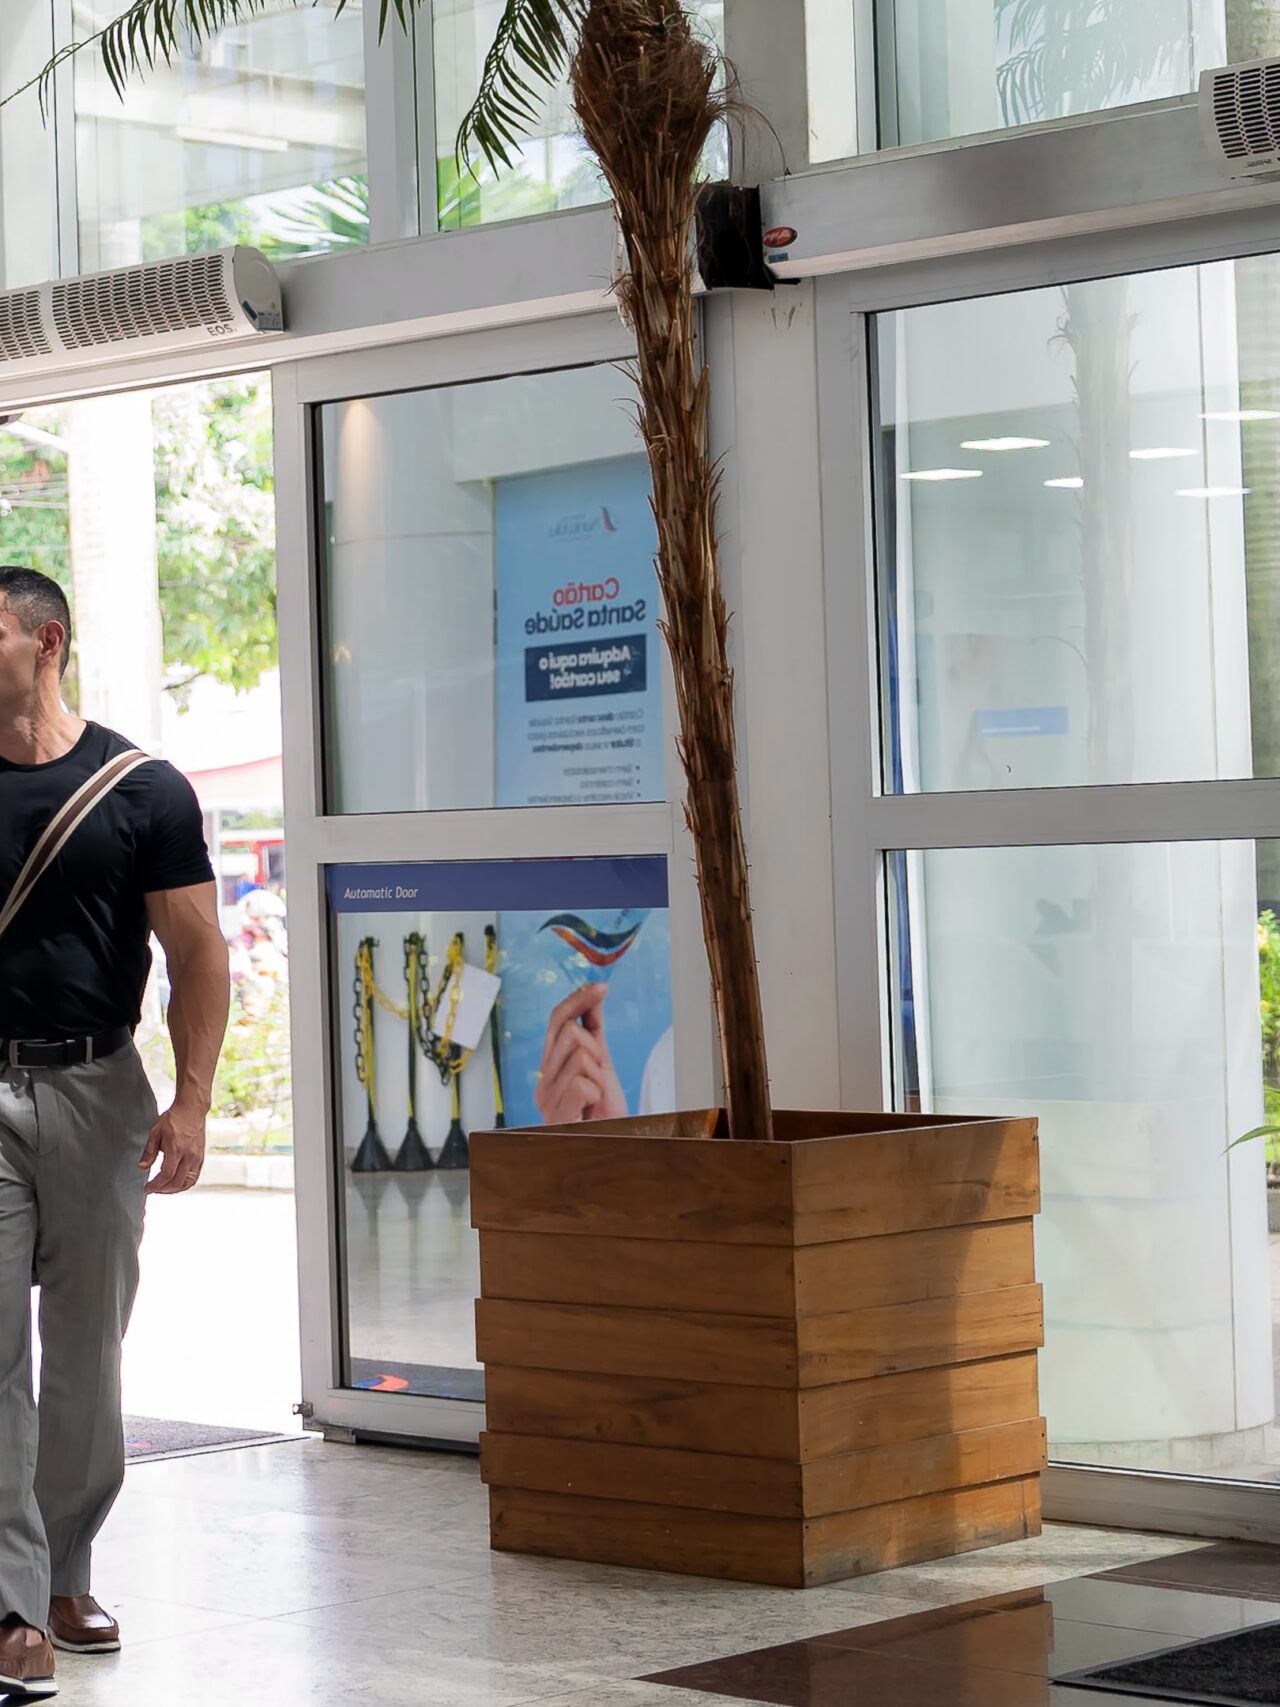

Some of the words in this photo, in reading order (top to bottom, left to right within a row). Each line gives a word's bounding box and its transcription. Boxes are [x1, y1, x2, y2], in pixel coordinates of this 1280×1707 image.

[207, 324, 234, 336] EOS
[344, 887, 393, 899] Automatic
[395, 886, 419, 898] Door
